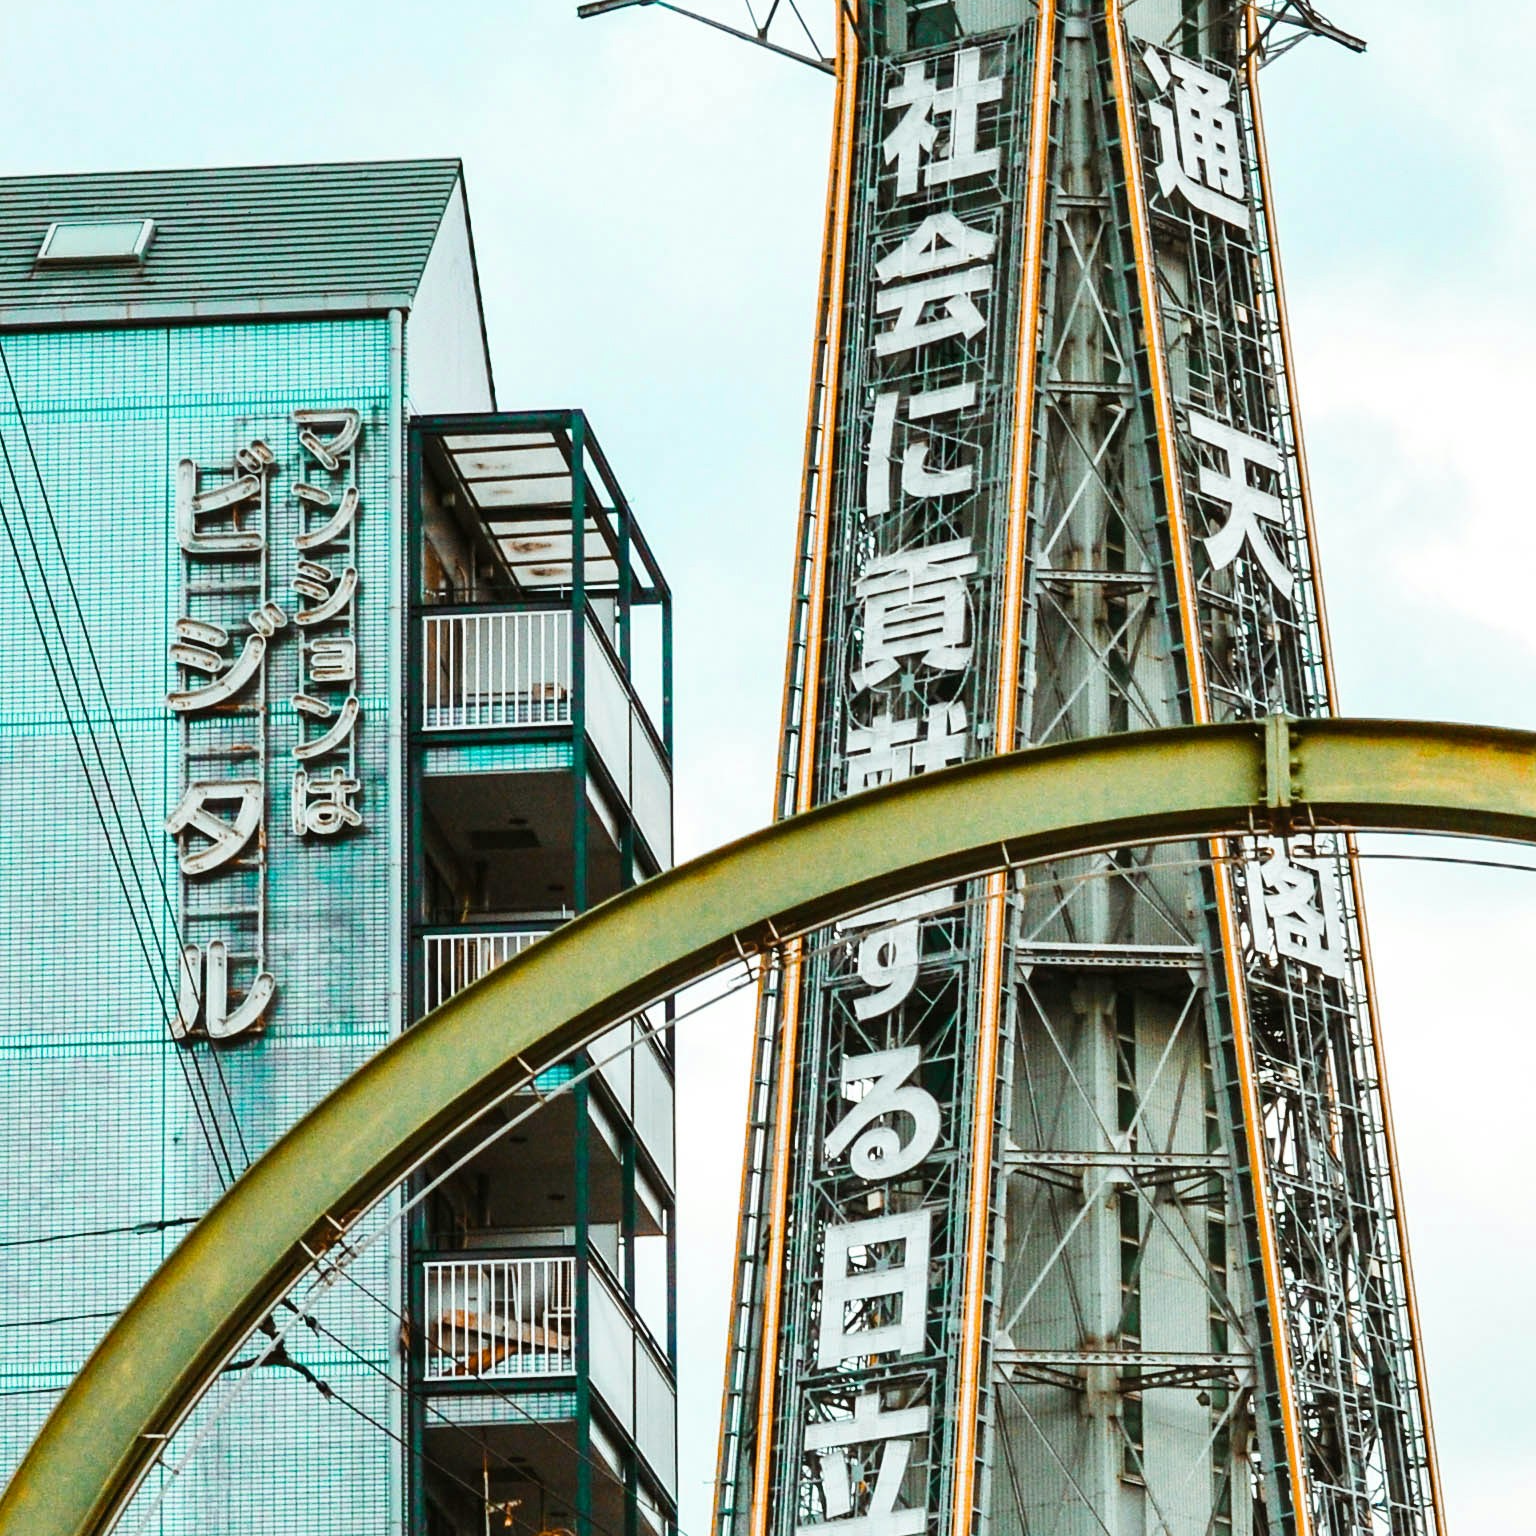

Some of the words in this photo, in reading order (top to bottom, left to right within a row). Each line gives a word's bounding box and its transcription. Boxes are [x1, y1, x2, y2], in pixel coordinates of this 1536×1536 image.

[164, 439, 288, 1039] ビジタル
[290, 407, 362, 835] マンションは
[1144, 46, 1344, 978] 通天閣
